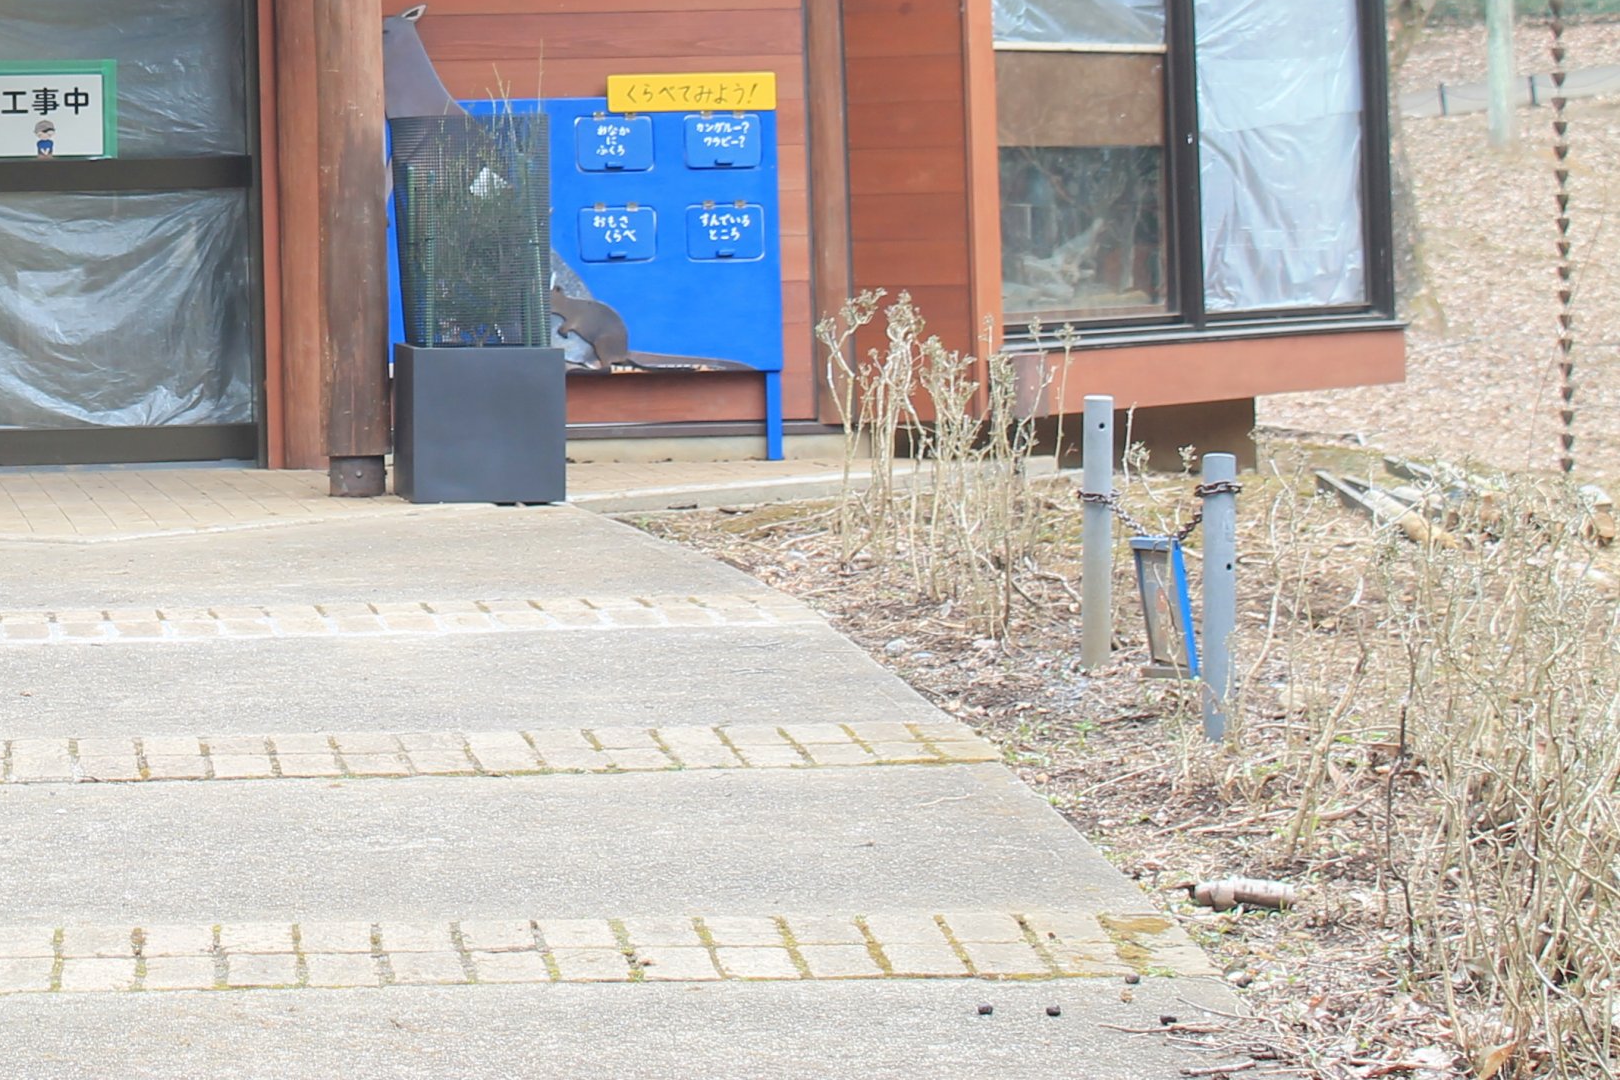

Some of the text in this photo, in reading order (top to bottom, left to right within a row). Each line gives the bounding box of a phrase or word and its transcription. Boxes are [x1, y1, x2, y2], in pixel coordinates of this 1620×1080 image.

[626, 83, 759, 104] くらべてみよう!
[1, 87, 89, 115] 工事中
[597, 124, 630, 137] おなか
[605, 136, 617, 145] に
[703, 135, 746, 149] ワラビー?
[596, 144, 625, 156] ふくろ
[593, 215, 629, 229] おもさ
[699, 213, 751, 227] すんでいる
[605, 229, 637, 243] くらべ
[709, 227, 741, 241] ところ
